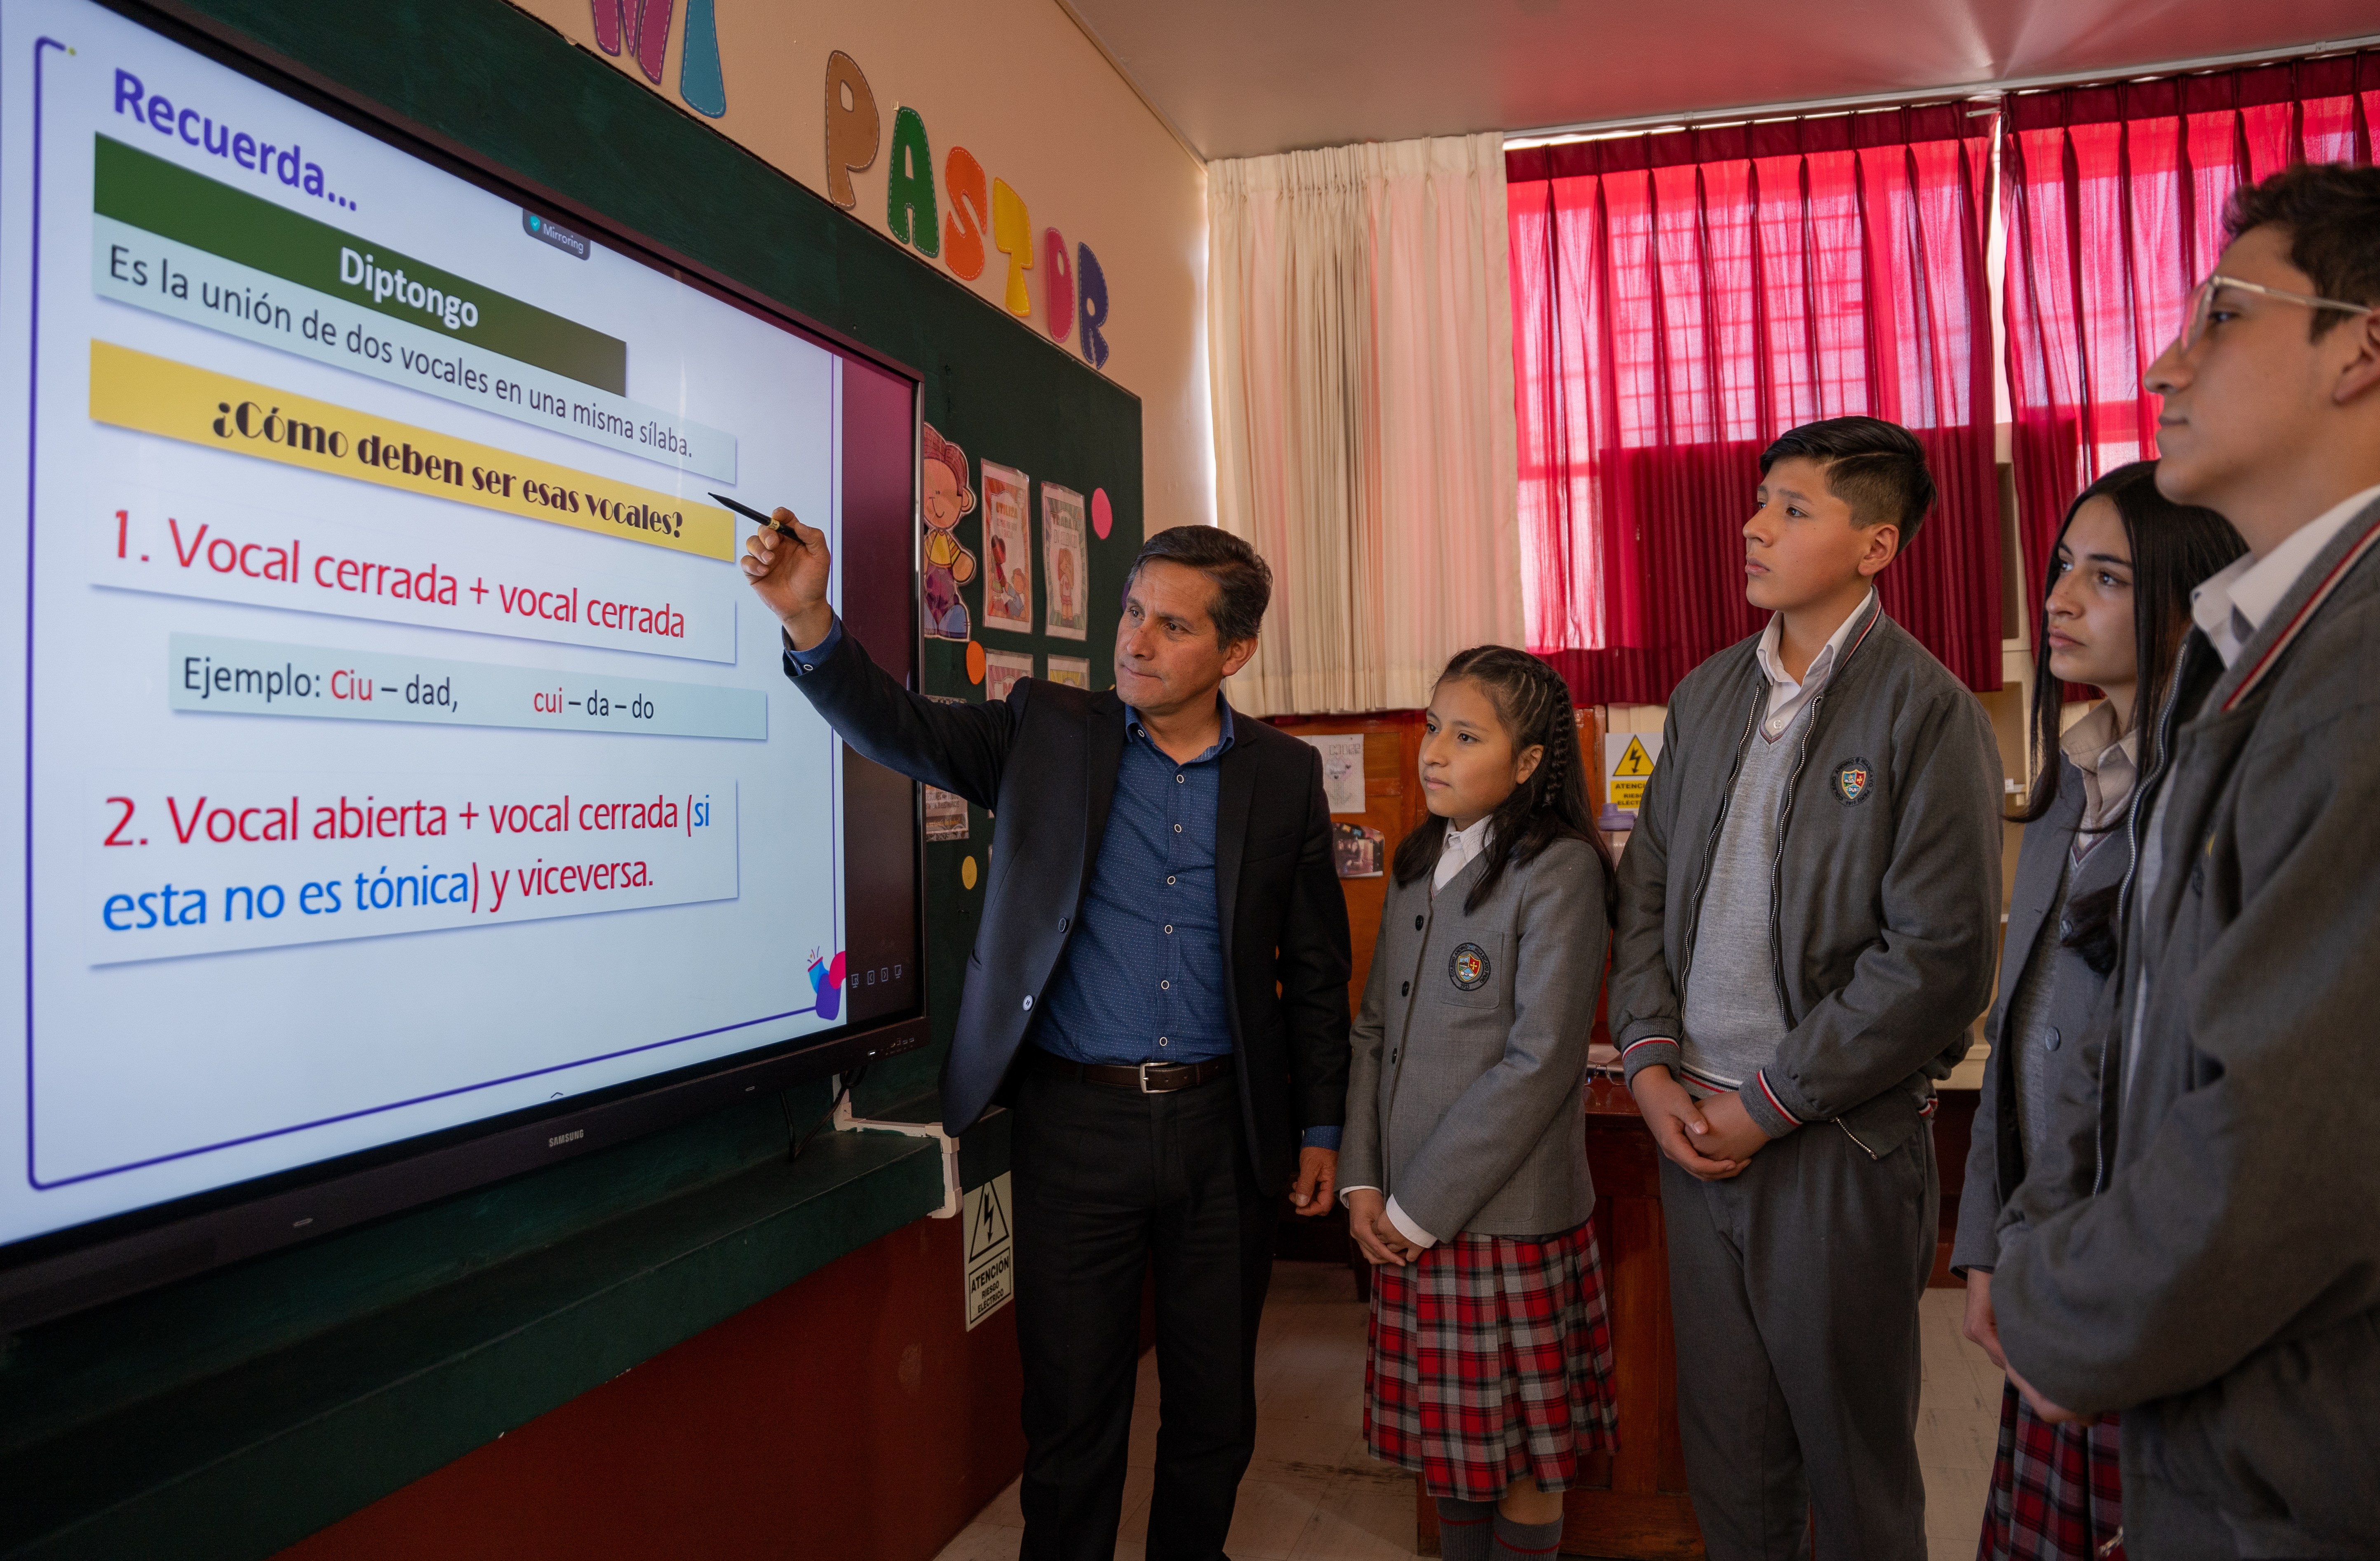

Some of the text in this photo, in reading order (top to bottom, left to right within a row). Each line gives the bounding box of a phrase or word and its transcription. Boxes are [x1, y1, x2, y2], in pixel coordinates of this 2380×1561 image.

[114, 67, 357, 212] Recuerda...
[826, 49, 1109, 370] PASTOR
[543, 223, 584, 255] Mirroring
[340, 247, 479, 330] Diptongo
[110, 244, 693, 458] Es la unión de dos vocales en una misma sílaba.
[212, 401, 684, 538] ¿Cómo deben ser esas vocales?
[115, 510, 685, 638] 1. Vocal cerrada + vocal cerrada
[184, 656, 320, 702] Ejemplo:
[331, 669, 373, 701] Ciu
[405, 673, 458, 713] dad,
[533, 687, 563, 714] cui
[587, 689, 609, 717] da
[632, 693, 654, 719] do
[103, 794, 710, 847] 2. Vocal abierta + vocal cerrada (si
[103, 858, 653, 931] esta no es tónica) y viceversa.
[1454, 945, 1468, 957] ANDINO
[1474, 947, 1489, 971] HUANCAYO
[1479, 971, 1488, 984] PERU
[549, 1128, 584, 1148] SAMSUNG
[970, 1255, 1009, 1294] ATENCIÓN
[977, 1288, 1004, 1314] ELÉCTRICO
[982, 1280, 1000, 1300] RIESGO
